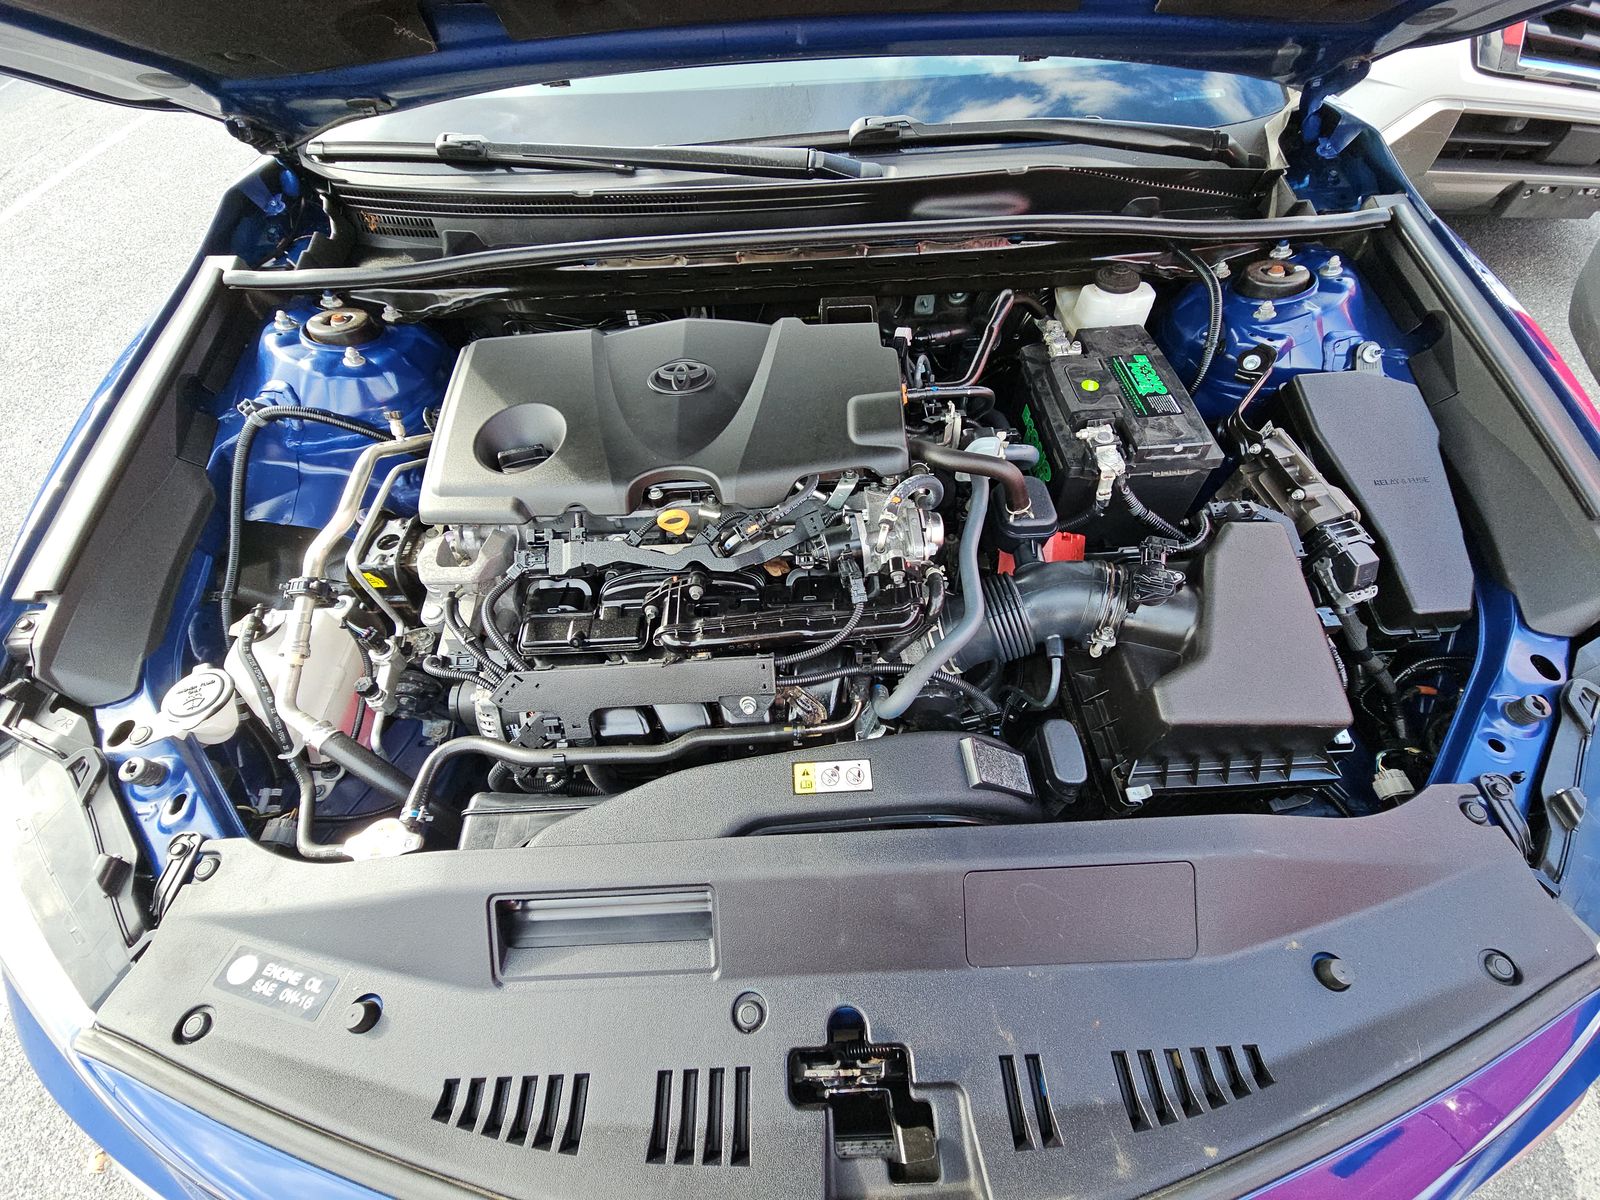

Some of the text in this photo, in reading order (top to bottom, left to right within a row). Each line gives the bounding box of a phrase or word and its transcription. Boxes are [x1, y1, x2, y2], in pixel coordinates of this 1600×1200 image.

[1373, 478, 1399, 486] RELAY
[251, 978, 278, 997] SAE
[262, 962, 323, 994] ENGINE OIL
